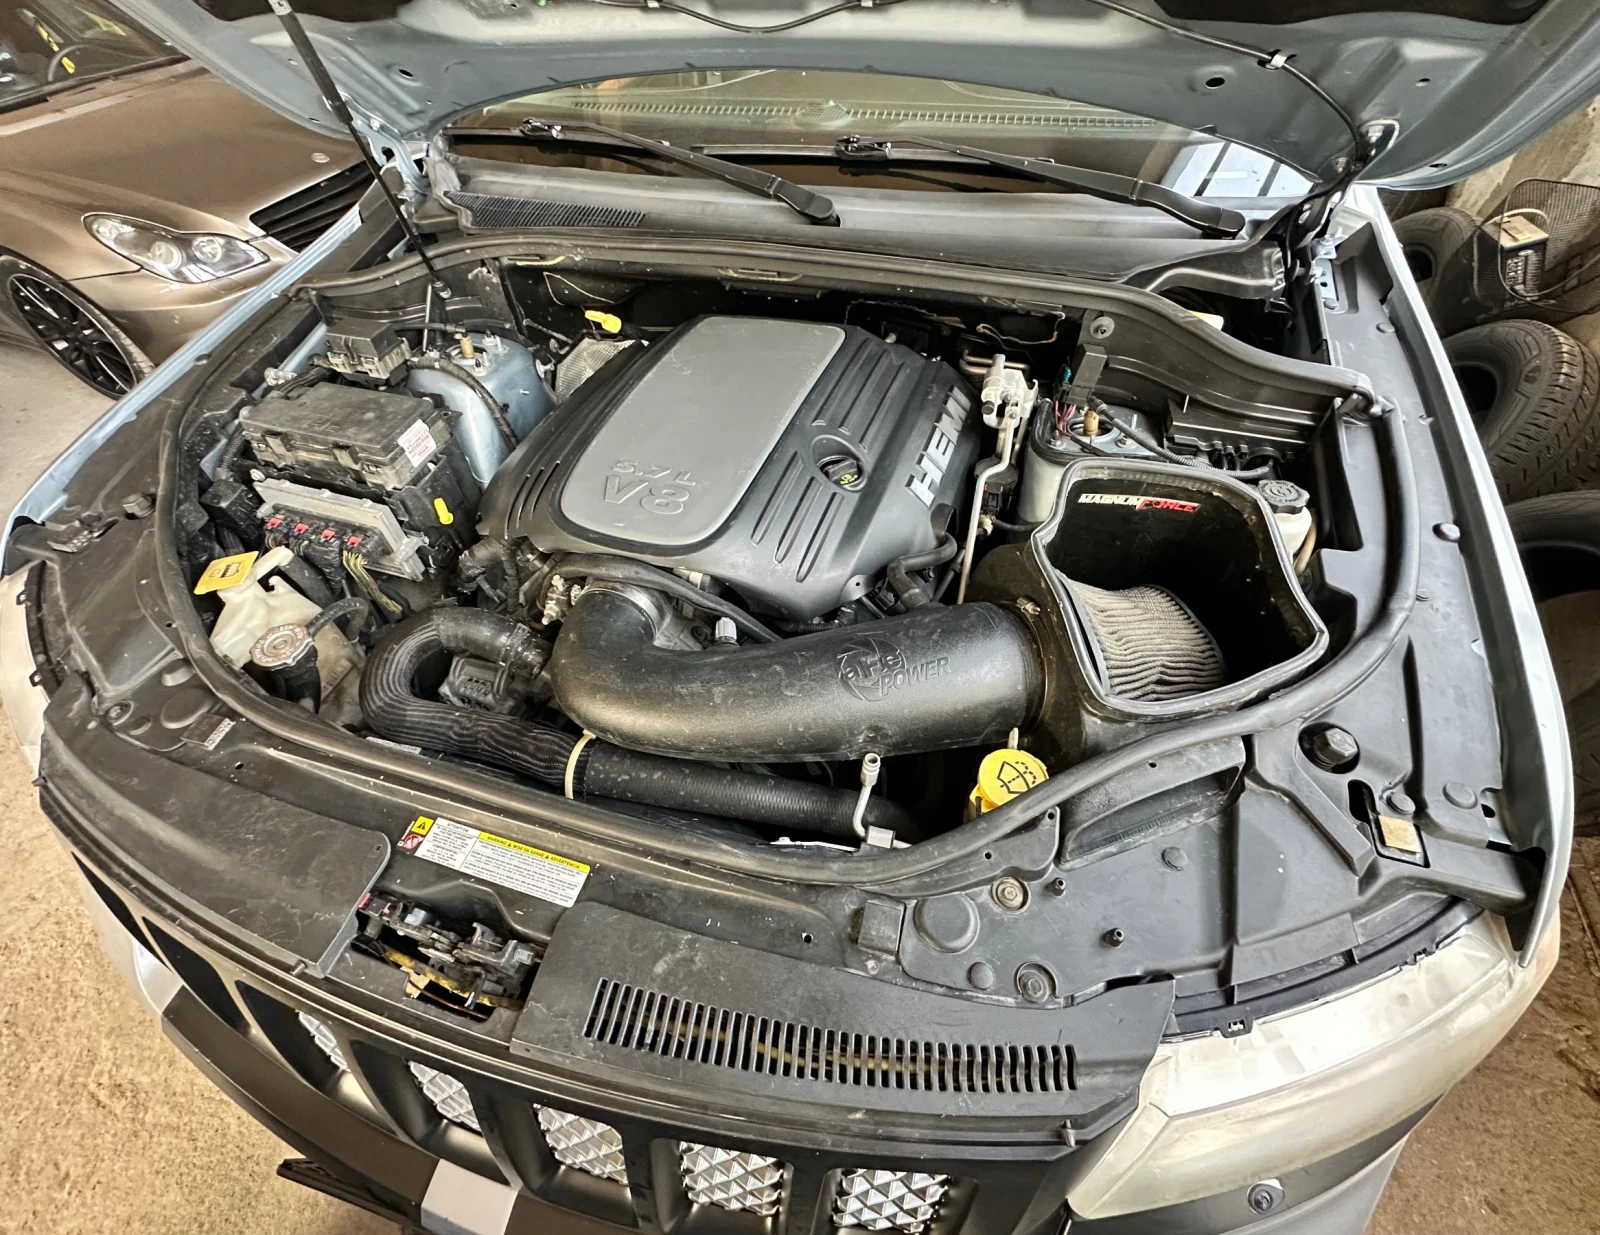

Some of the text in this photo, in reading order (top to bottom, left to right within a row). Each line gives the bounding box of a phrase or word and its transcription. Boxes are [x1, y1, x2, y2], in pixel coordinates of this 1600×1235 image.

[905, 386, 972, 508] HEMI
[604, 475, 690, 515] V8
[879, 657, 952, 697] POWER
